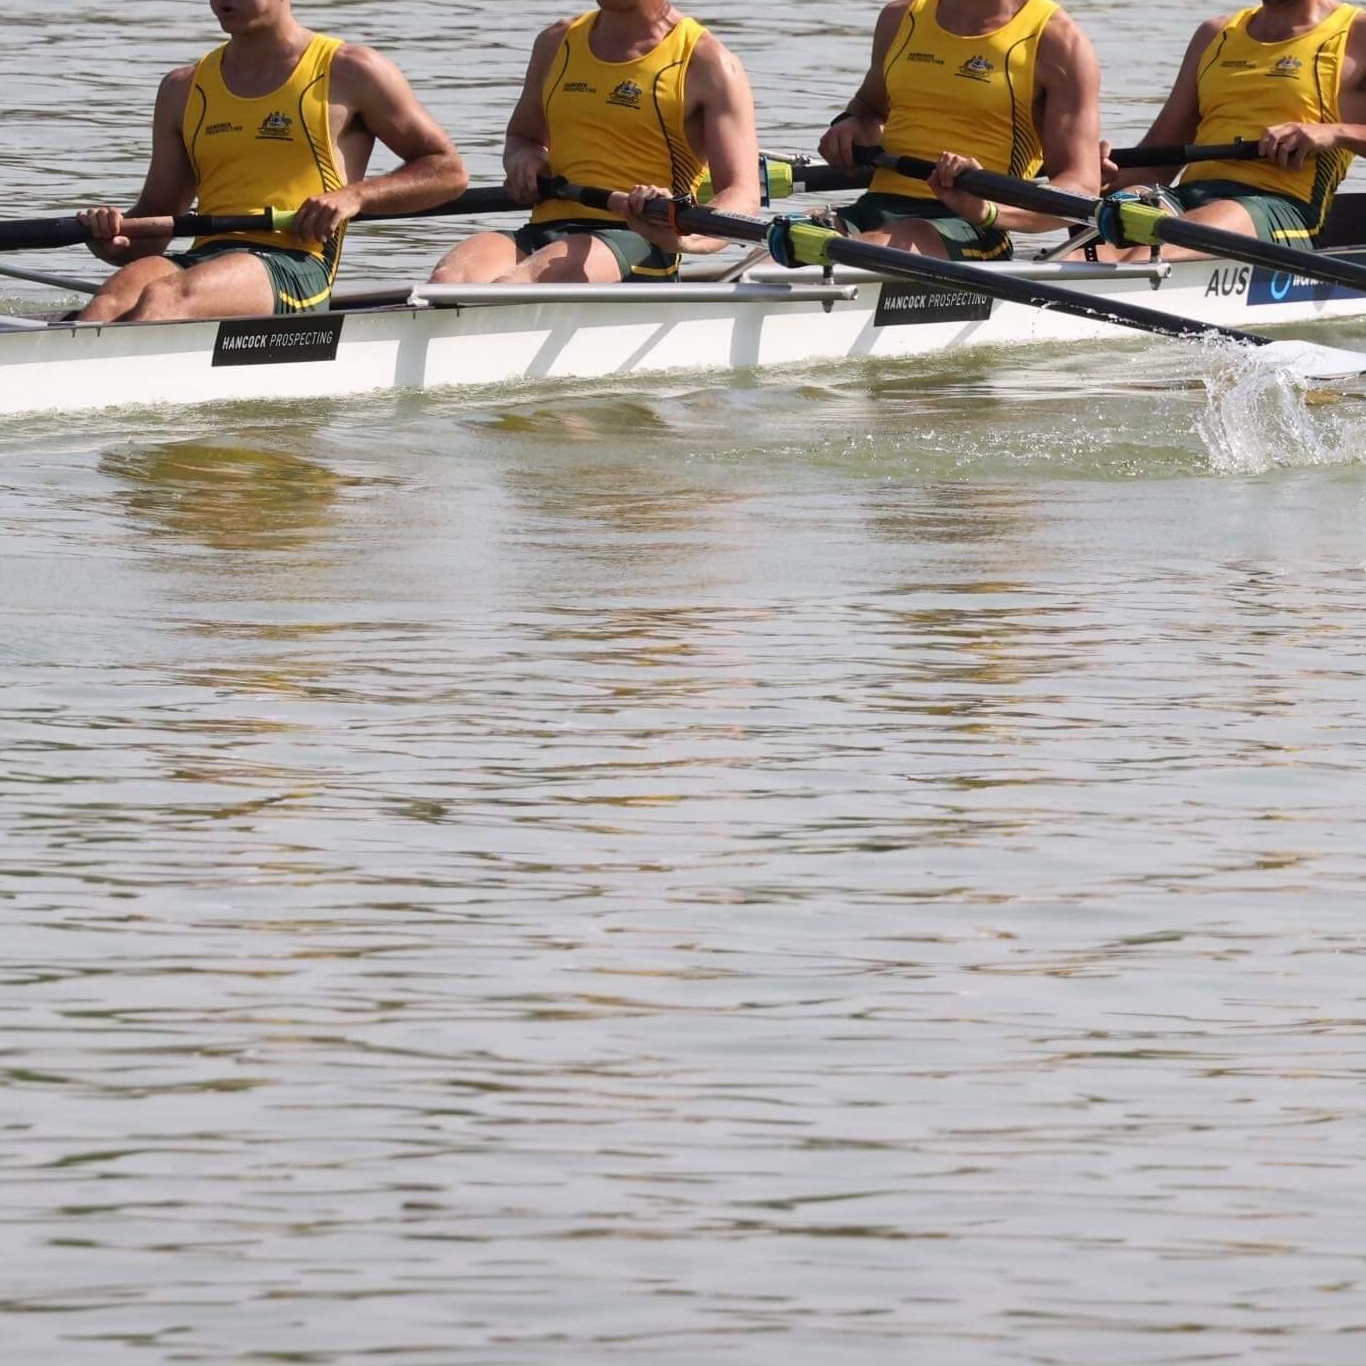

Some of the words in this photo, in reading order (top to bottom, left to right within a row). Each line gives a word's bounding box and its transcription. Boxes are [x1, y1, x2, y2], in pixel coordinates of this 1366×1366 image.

[1204, 266, 1250, 297] AUS
[884, 294, 927, 310] HANCOCK
[221, 334, 268, 350] HANCOCK
[269, 331, 334, 347] PROSPECTING
